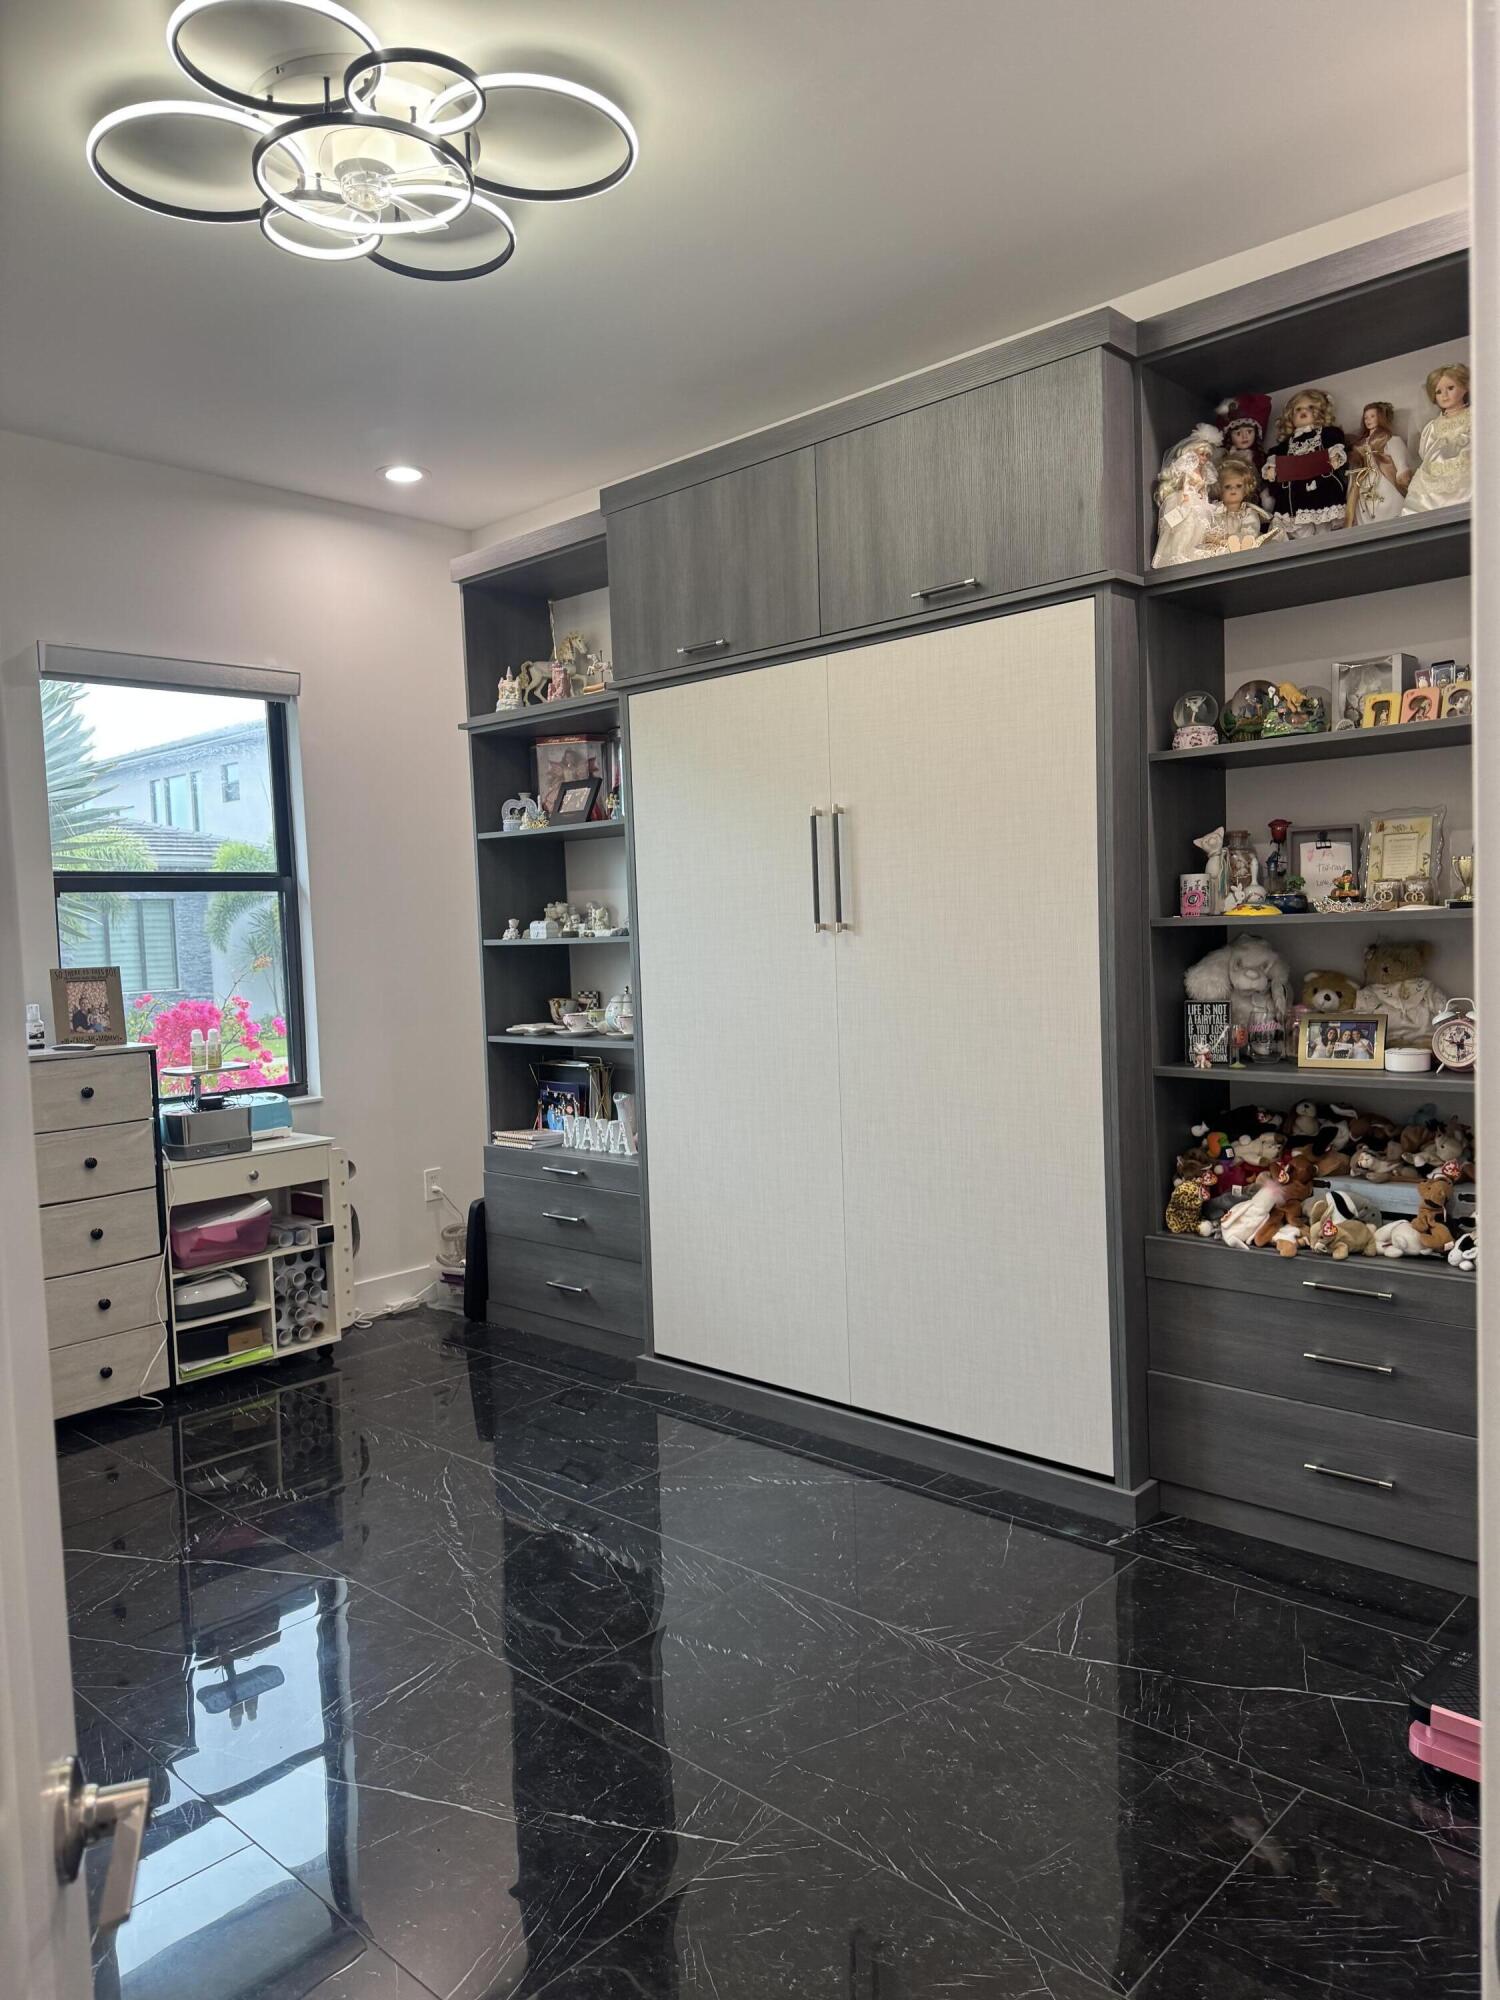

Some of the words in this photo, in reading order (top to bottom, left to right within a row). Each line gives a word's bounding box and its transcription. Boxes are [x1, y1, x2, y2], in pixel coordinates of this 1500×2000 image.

[1187, 1004, 1202, 1015] LIFE
[1203, 1004, 1211, 1015] IS
[1212, 1004, 1228, 1015] NOT
[1188, 1014, 1194, 1025] A
[1194, 1014, 1228, 1025] FAIRYTALE
[1188, 1024, 1195, 1035] IF
[1196, 1024, 1210, 1035] YOU
[1188, 1034, 1207, 1045] YOUR
[1209, 1034, 1228, 1045] SH
[562, 1114, 633, 1156] MAMA
